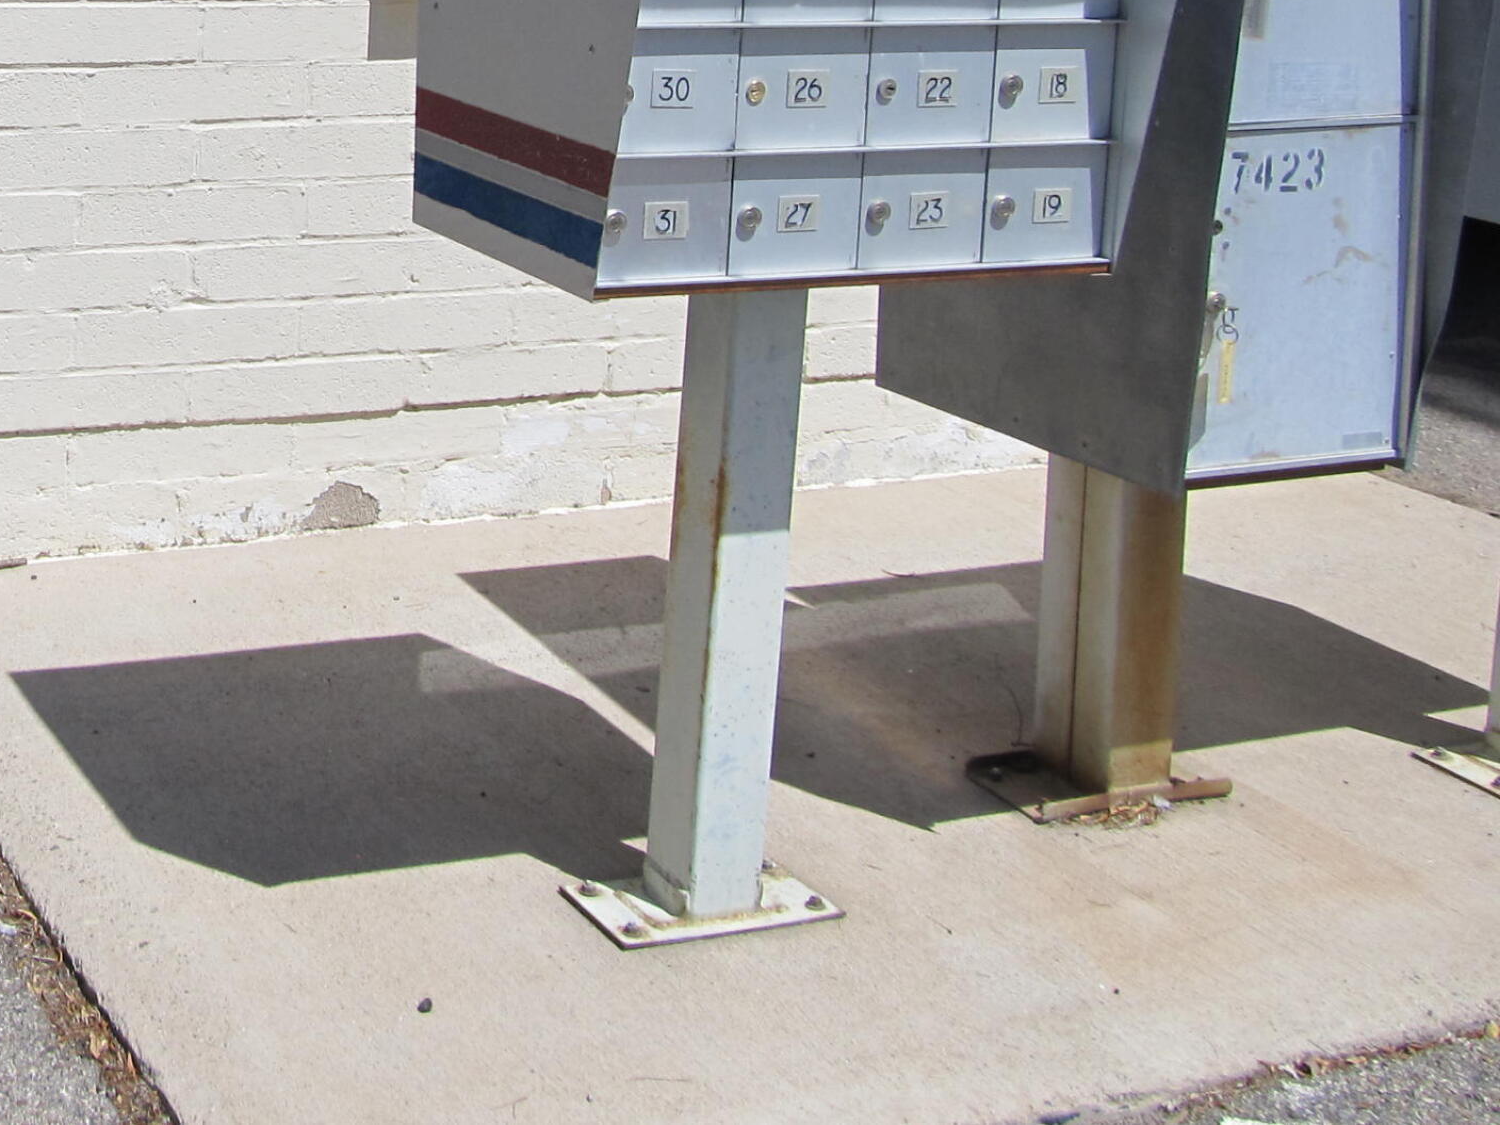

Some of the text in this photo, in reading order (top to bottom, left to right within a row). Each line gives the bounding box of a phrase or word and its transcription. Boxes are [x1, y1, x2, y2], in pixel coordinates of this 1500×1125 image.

[658, 76, 691, 102] 30
[794, 77, 823, 103] 26
[924, 76, 953, 104] 22
[1050, 73, 1068, 99] 18
[1230, 147, 1325, 195] 7423
[784, 202, 813, 228] 27
[916, 197, 944, 225] 23
[1042, 194, 1062, 219] 19
[654, 208, 677, 235] 31
